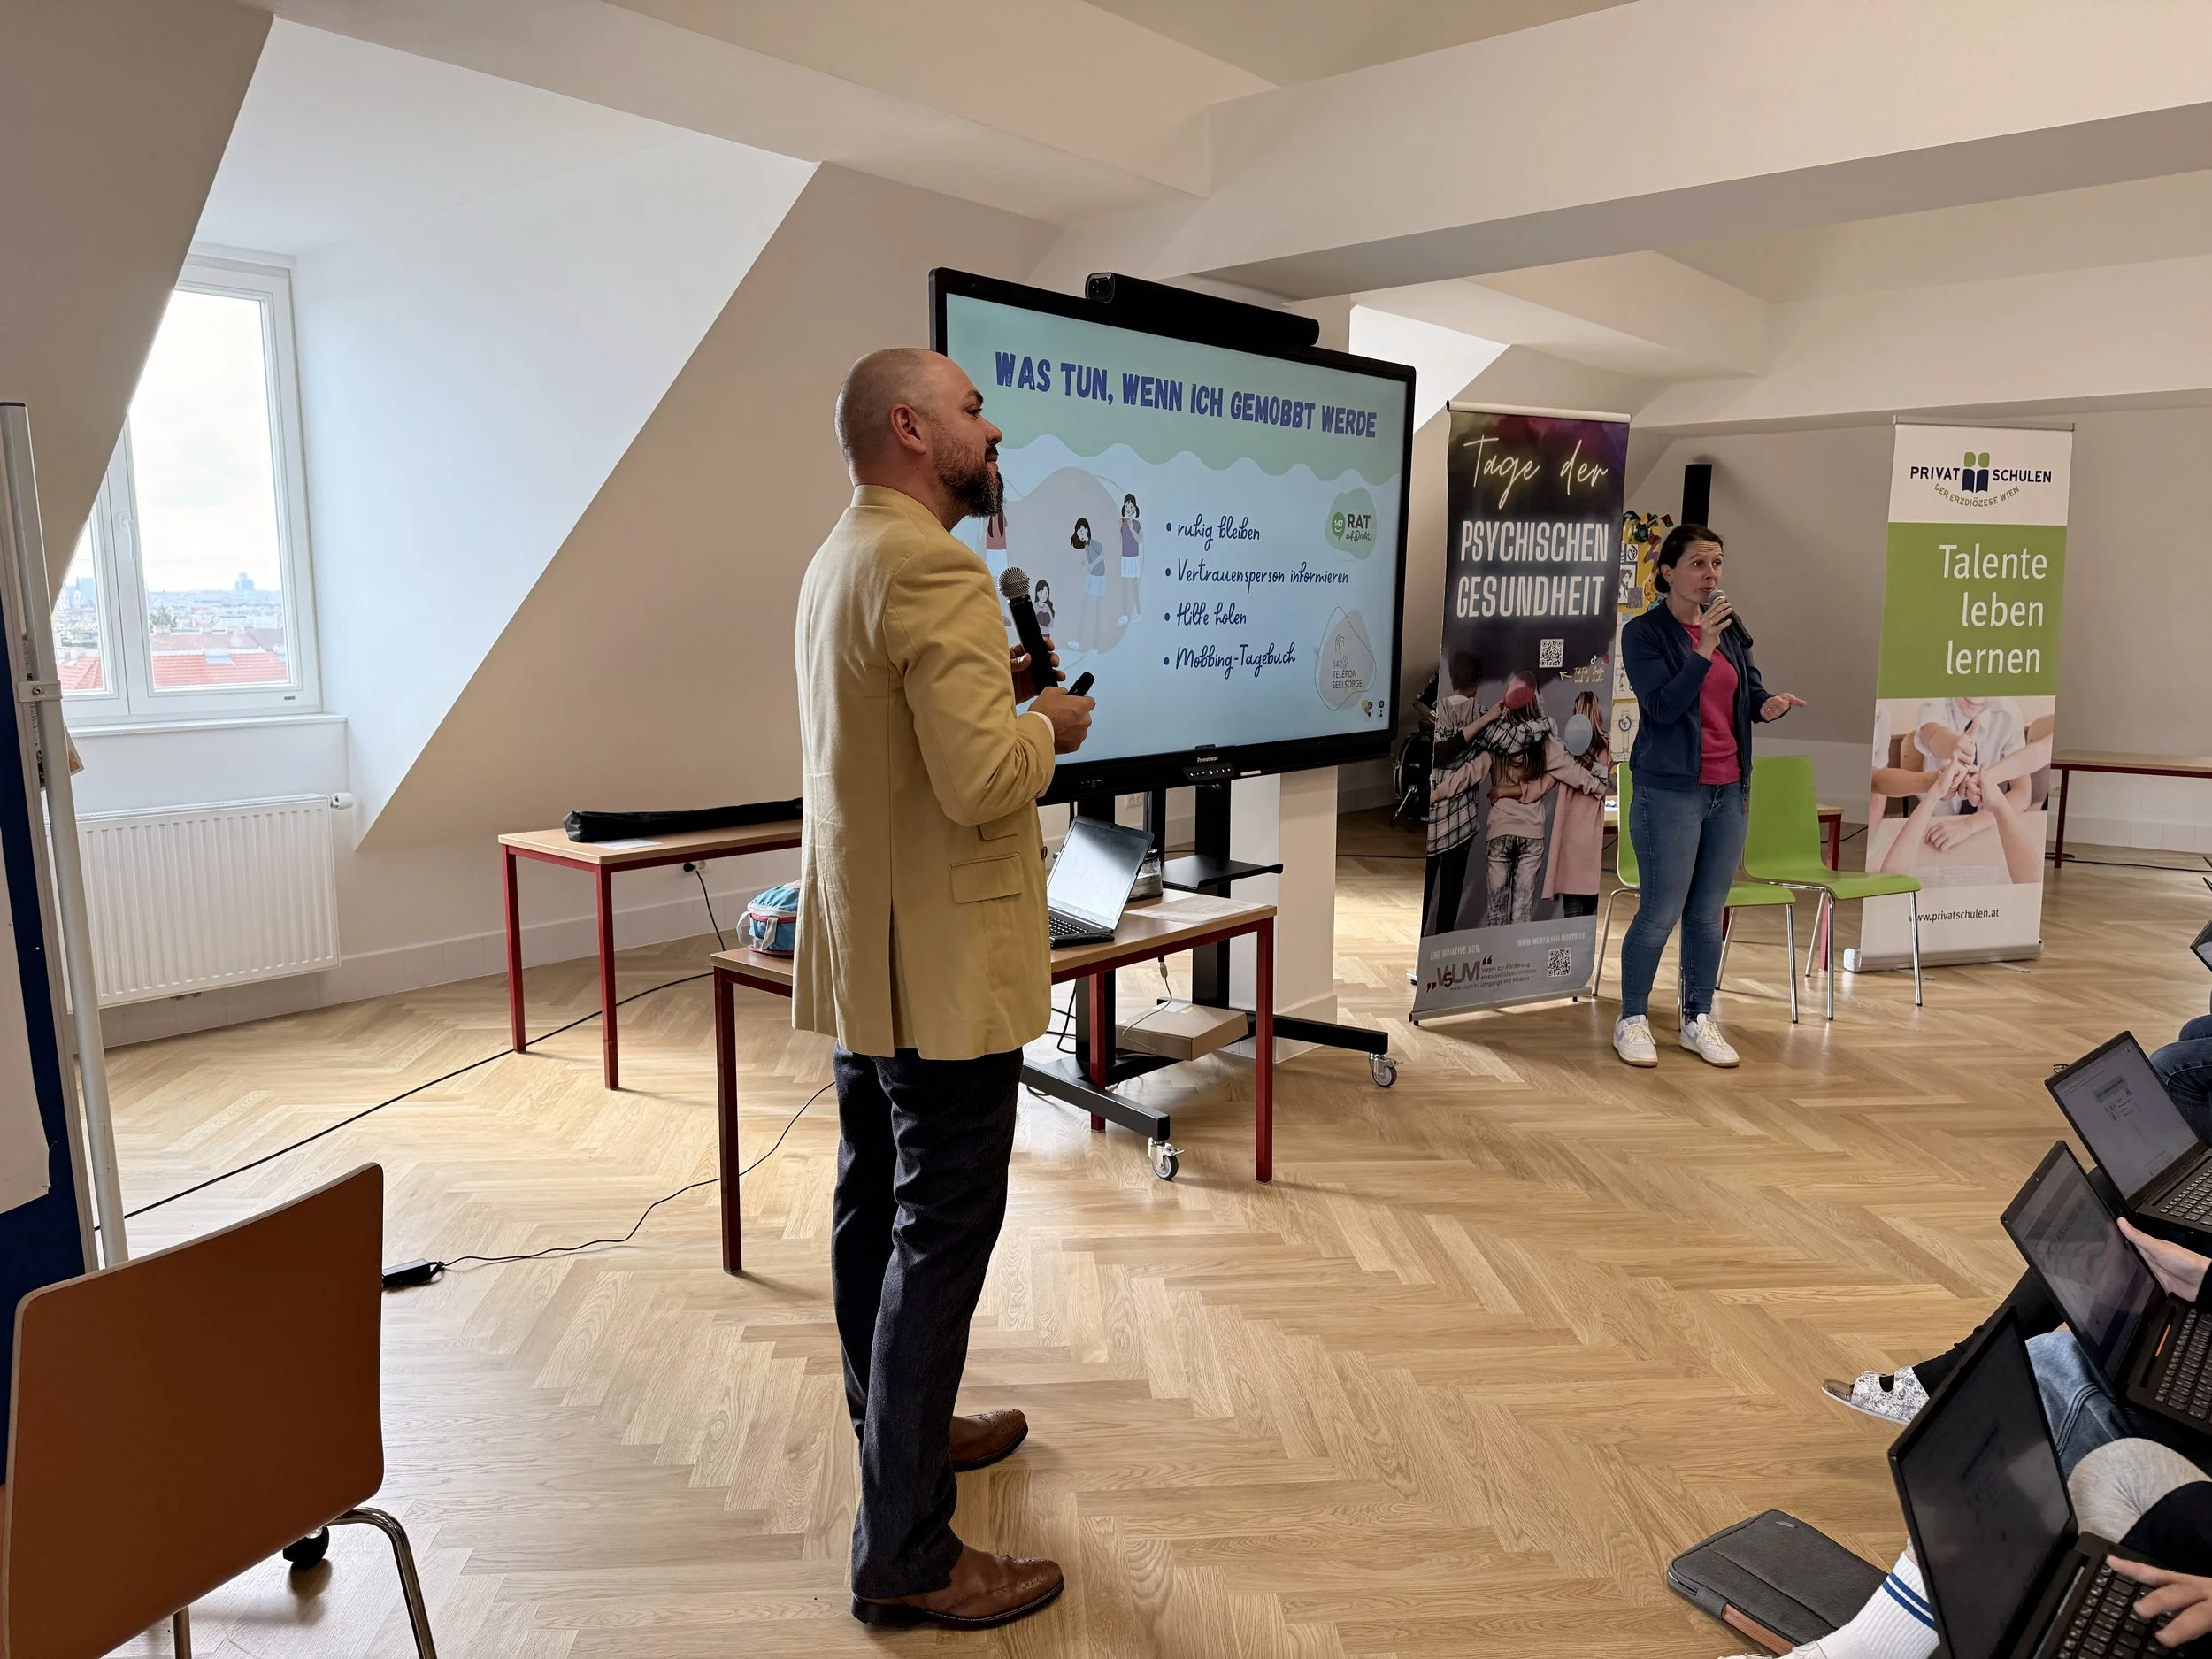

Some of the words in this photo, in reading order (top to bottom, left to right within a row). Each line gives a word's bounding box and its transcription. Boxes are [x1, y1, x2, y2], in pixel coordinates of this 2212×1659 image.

[995, 351, 1051, 392] WAS
[1061, 362, 1114, 405] TUN,
[1122, 373, 1183, 411] WENN
[1190, 383, 1224, 417] ICH
[1230, 391, 1316, 430] GEMOBBT
[1322, 404, 1378, 438] WERDE
[1463, 434, 1540, 510] Tage
[1560, 439, 1608, 496] der
[1910, 466, 1961, 480] PRIVAT
[1993, 469, 2052, 483] SCHULEN
[1934, 483, 1949, 499] DER
[1949, 494, 1999, 508] ERZDIÖZESE
[2000, 486, 2020, 502] WIEN
[1177, 514, 1214, 551] ruhig
[1217, 515, 1260, 541] bleiben
[1347, 513, 1371, 529] RAT
[1460, 520, 1609, 563] PSYCHISCHEN
[1178, 558, 1285, 594] Vertrauensperson
[1290, 561, 1348, 584] informieren
[1939, 543, 2047, 580] Talente
[1177, 602, 1209, 626] Hilfe
[1214, 602, 1247, 626] holen
[1456, 576, 1605, 618] GESUNDHEIT
[1962, 591, 2044, 627] leben
[1176, 641, 1296, 680] Mobbing-Tagebuch
[1333, 670, 1357, 680] TELEFON
[1947, 640, 2040, 675] lernen
[1332, 680, 1363, 689] SEELSORGE
